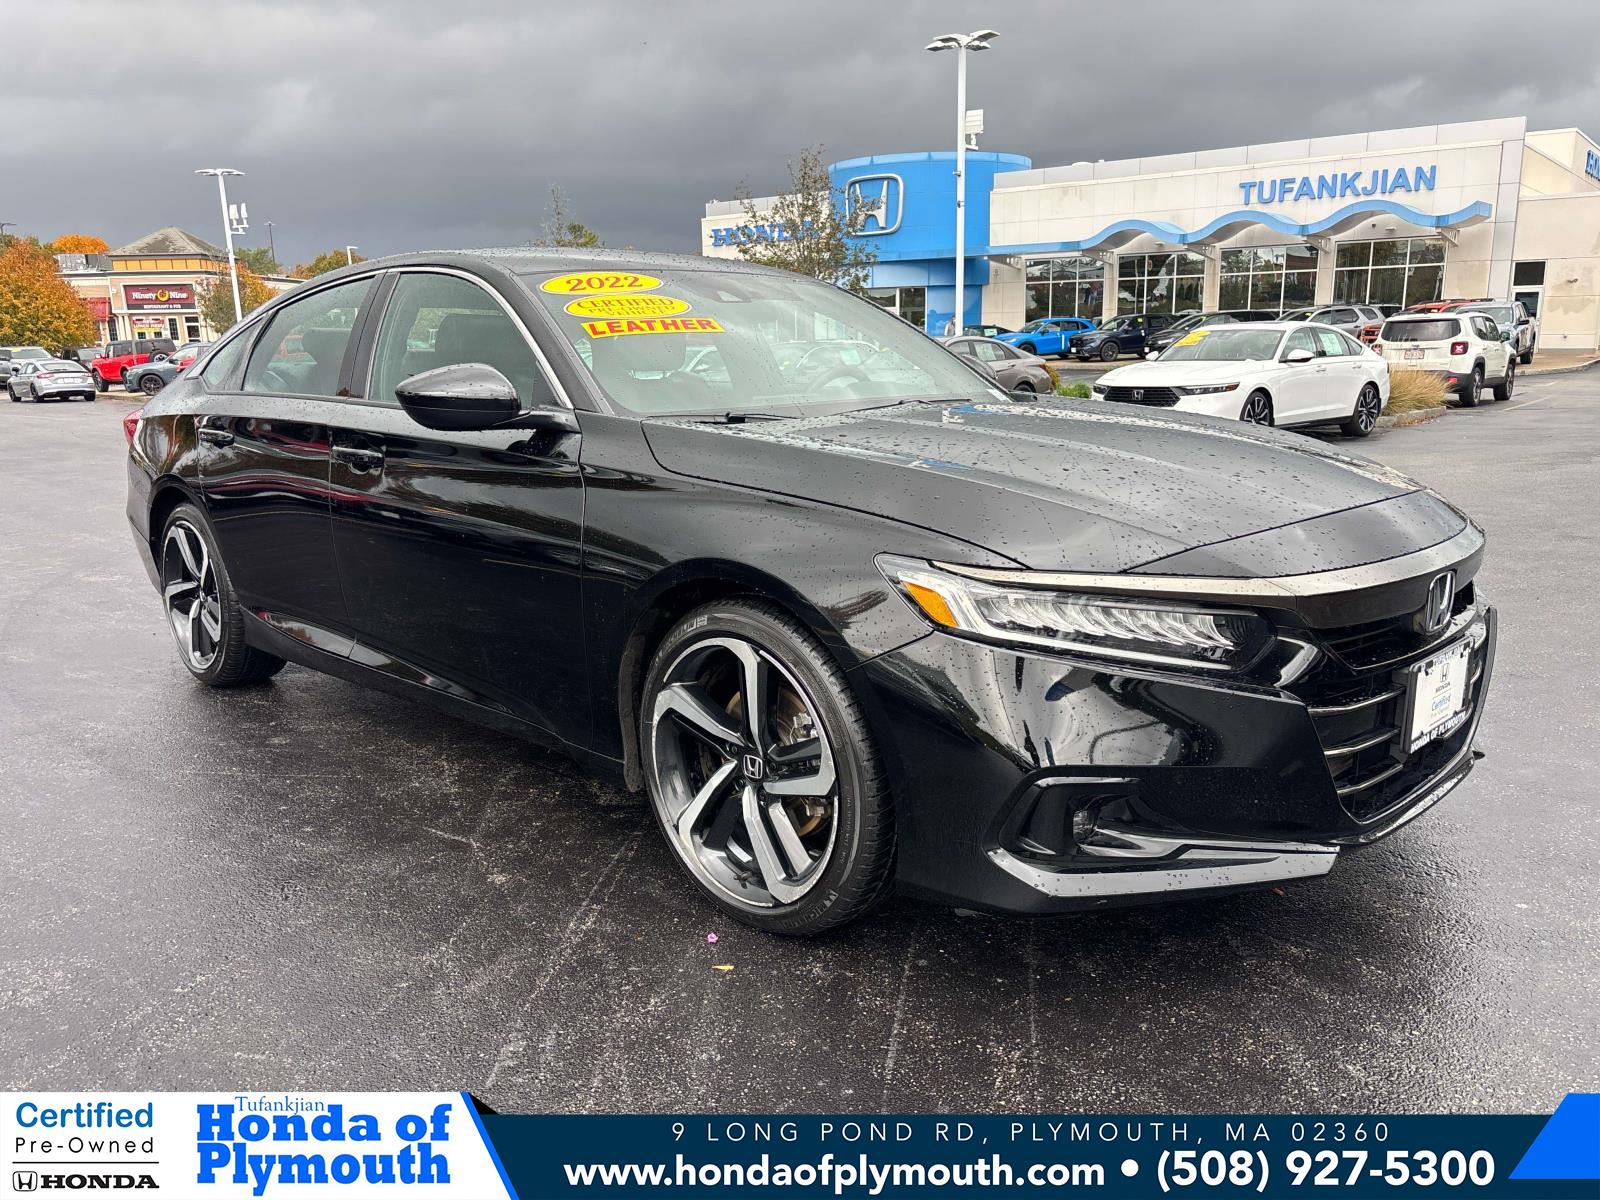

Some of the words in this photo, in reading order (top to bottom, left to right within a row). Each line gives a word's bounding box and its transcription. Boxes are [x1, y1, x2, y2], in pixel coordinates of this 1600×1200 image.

[1239, 165, 1437, 206] TUFANKJIAN
[565, 276, 643, 292] 2022
[132, 291, 156, 300] Ninety
[169, 291, 187, 299] Nine
[577, 298, 674, 309] CERTIFIED
[589, 319, 719, 336] LEATHER
[1410, 733, 1430, 754] HONDA
